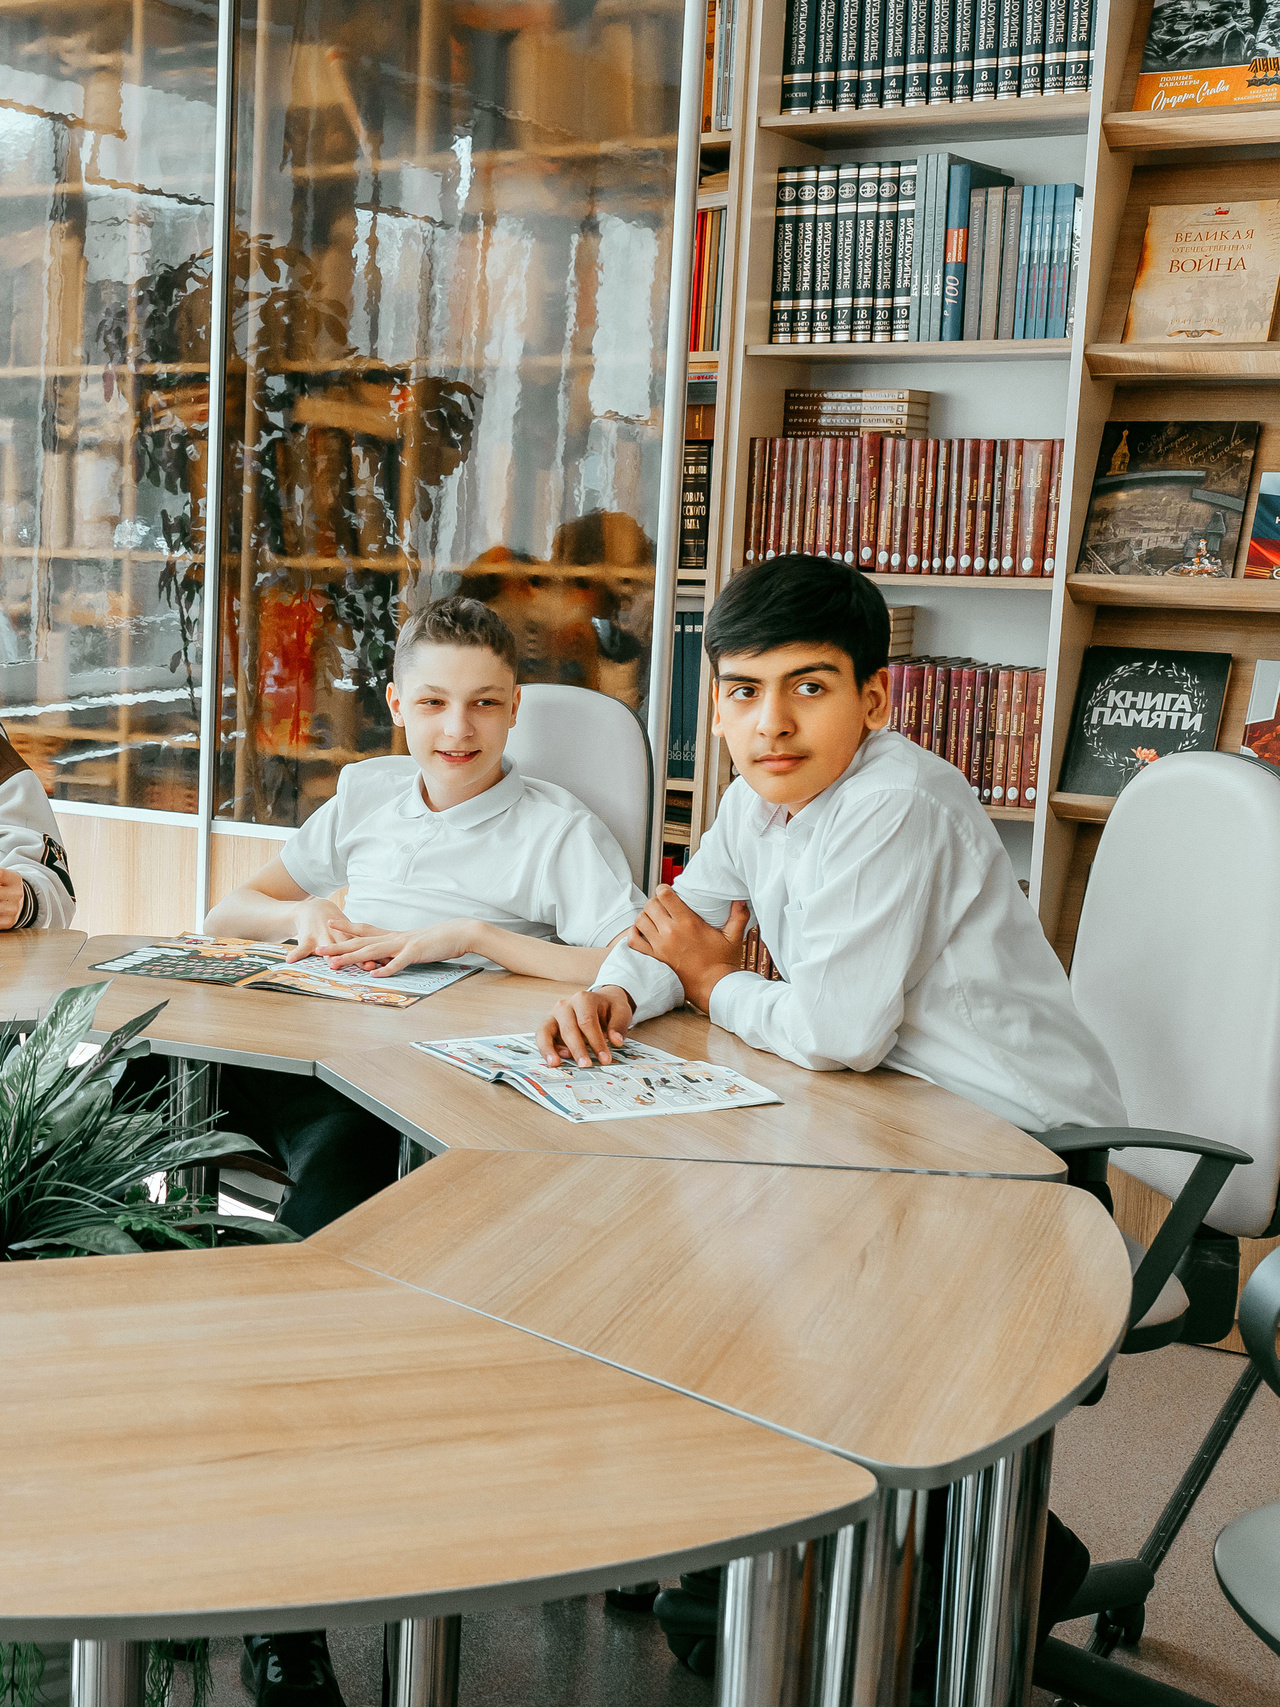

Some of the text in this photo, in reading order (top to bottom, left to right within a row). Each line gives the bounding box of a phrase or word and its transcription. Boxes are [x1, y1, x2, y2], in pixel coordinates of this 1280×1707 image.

[848, 0, 858, 61] ЭНЦИКЛОПЕД
[870, 0, 880, 61] ЭНЦИКЛОПЕД
[894, 0, 904, 57] ЭНЦИКЛОПЕД
[917, 0, 926, 54] ЭНЦИКЛОПЕ
[940, 0, 949, 53] ЭНЦИКЛОПЕ
[962, 0, 971, 51] ЭНЦИКЛОП
[986, 0, 996, 49] ЭНЦИКЛОП
[1009, 0, 1019, 47] ЭНЦИКЛОП
[1033, 0, 1043, 44] ЭНЦИКЛО
[1056, 0, 1065, 43] ЭНЦИКЛО
[1079, 0, 1089, 41] ЭНЦИКЛО
[798, 0, 808, 65] ЭНЦИКЛОПЕДИ
[825, 0, 835, 62] ЭНЦИКЛОПЕД
[958, 74, 964, 83] 7
[981, 71, 988, 80] 8
[1005, 69, 1012, 79] 9
[1026, 67, 1038, 76] 10
[1049, 65, 1060, 75] 11
[1070, 64, 1083, 74] 12
[821, 84, 826, 93] 1
[844, 82, 850, 91] 2
[866, 82, 872, 92] 3
[890, 78, 896, 88] 4
[912, 76, 919, 85] 5
[936, 75, 943, 85] 6
[1159, 80, 1200, 88] КАВАЛЕРЫ
[1174, 229, 1254, 242] ВЕЛИКАЯ
[782, 224, 792, 291] ЭНЦИКЛОПЕДИЯ
[803, 222, 812, 291] ЭНЦИКЛОПЕДИЯ
[822, 222, 832, 290] ЭНЦИКЛОПЕДИЯ
[843, 220, 853, 289] ЭНЦИКЛОПЕДИЯ
[863, 220, 873, 289] ЭНЦИКЛОПЕДИЯ
[883, 220, 893, 289] ЭНЦИКЛОПЕДИЯ
[903, 218, 913, 288] ЭНЦИКЛОПЕДИЯ
[1172, 244, 1252, 254] ОТЕЧЕСТВЕННАЯ
[1168, 254, 1247, 273] ВОЙНА
[945, 275, 959, 305] 100
[797, 311, 807, 320] 15
[816, 311, 827, 320] 16
[838, 310, 848, 318] 17
[857, 310, 867, 318] 18
[877, 310, 888, 319] 20
[896, 309, 907, 318] 19
[683, 505, 706, 516] ССКОГО
[1107, 690, 1193, 712] КНИГА
[1091, 707, 1203, 732] ПАМЯТИ
